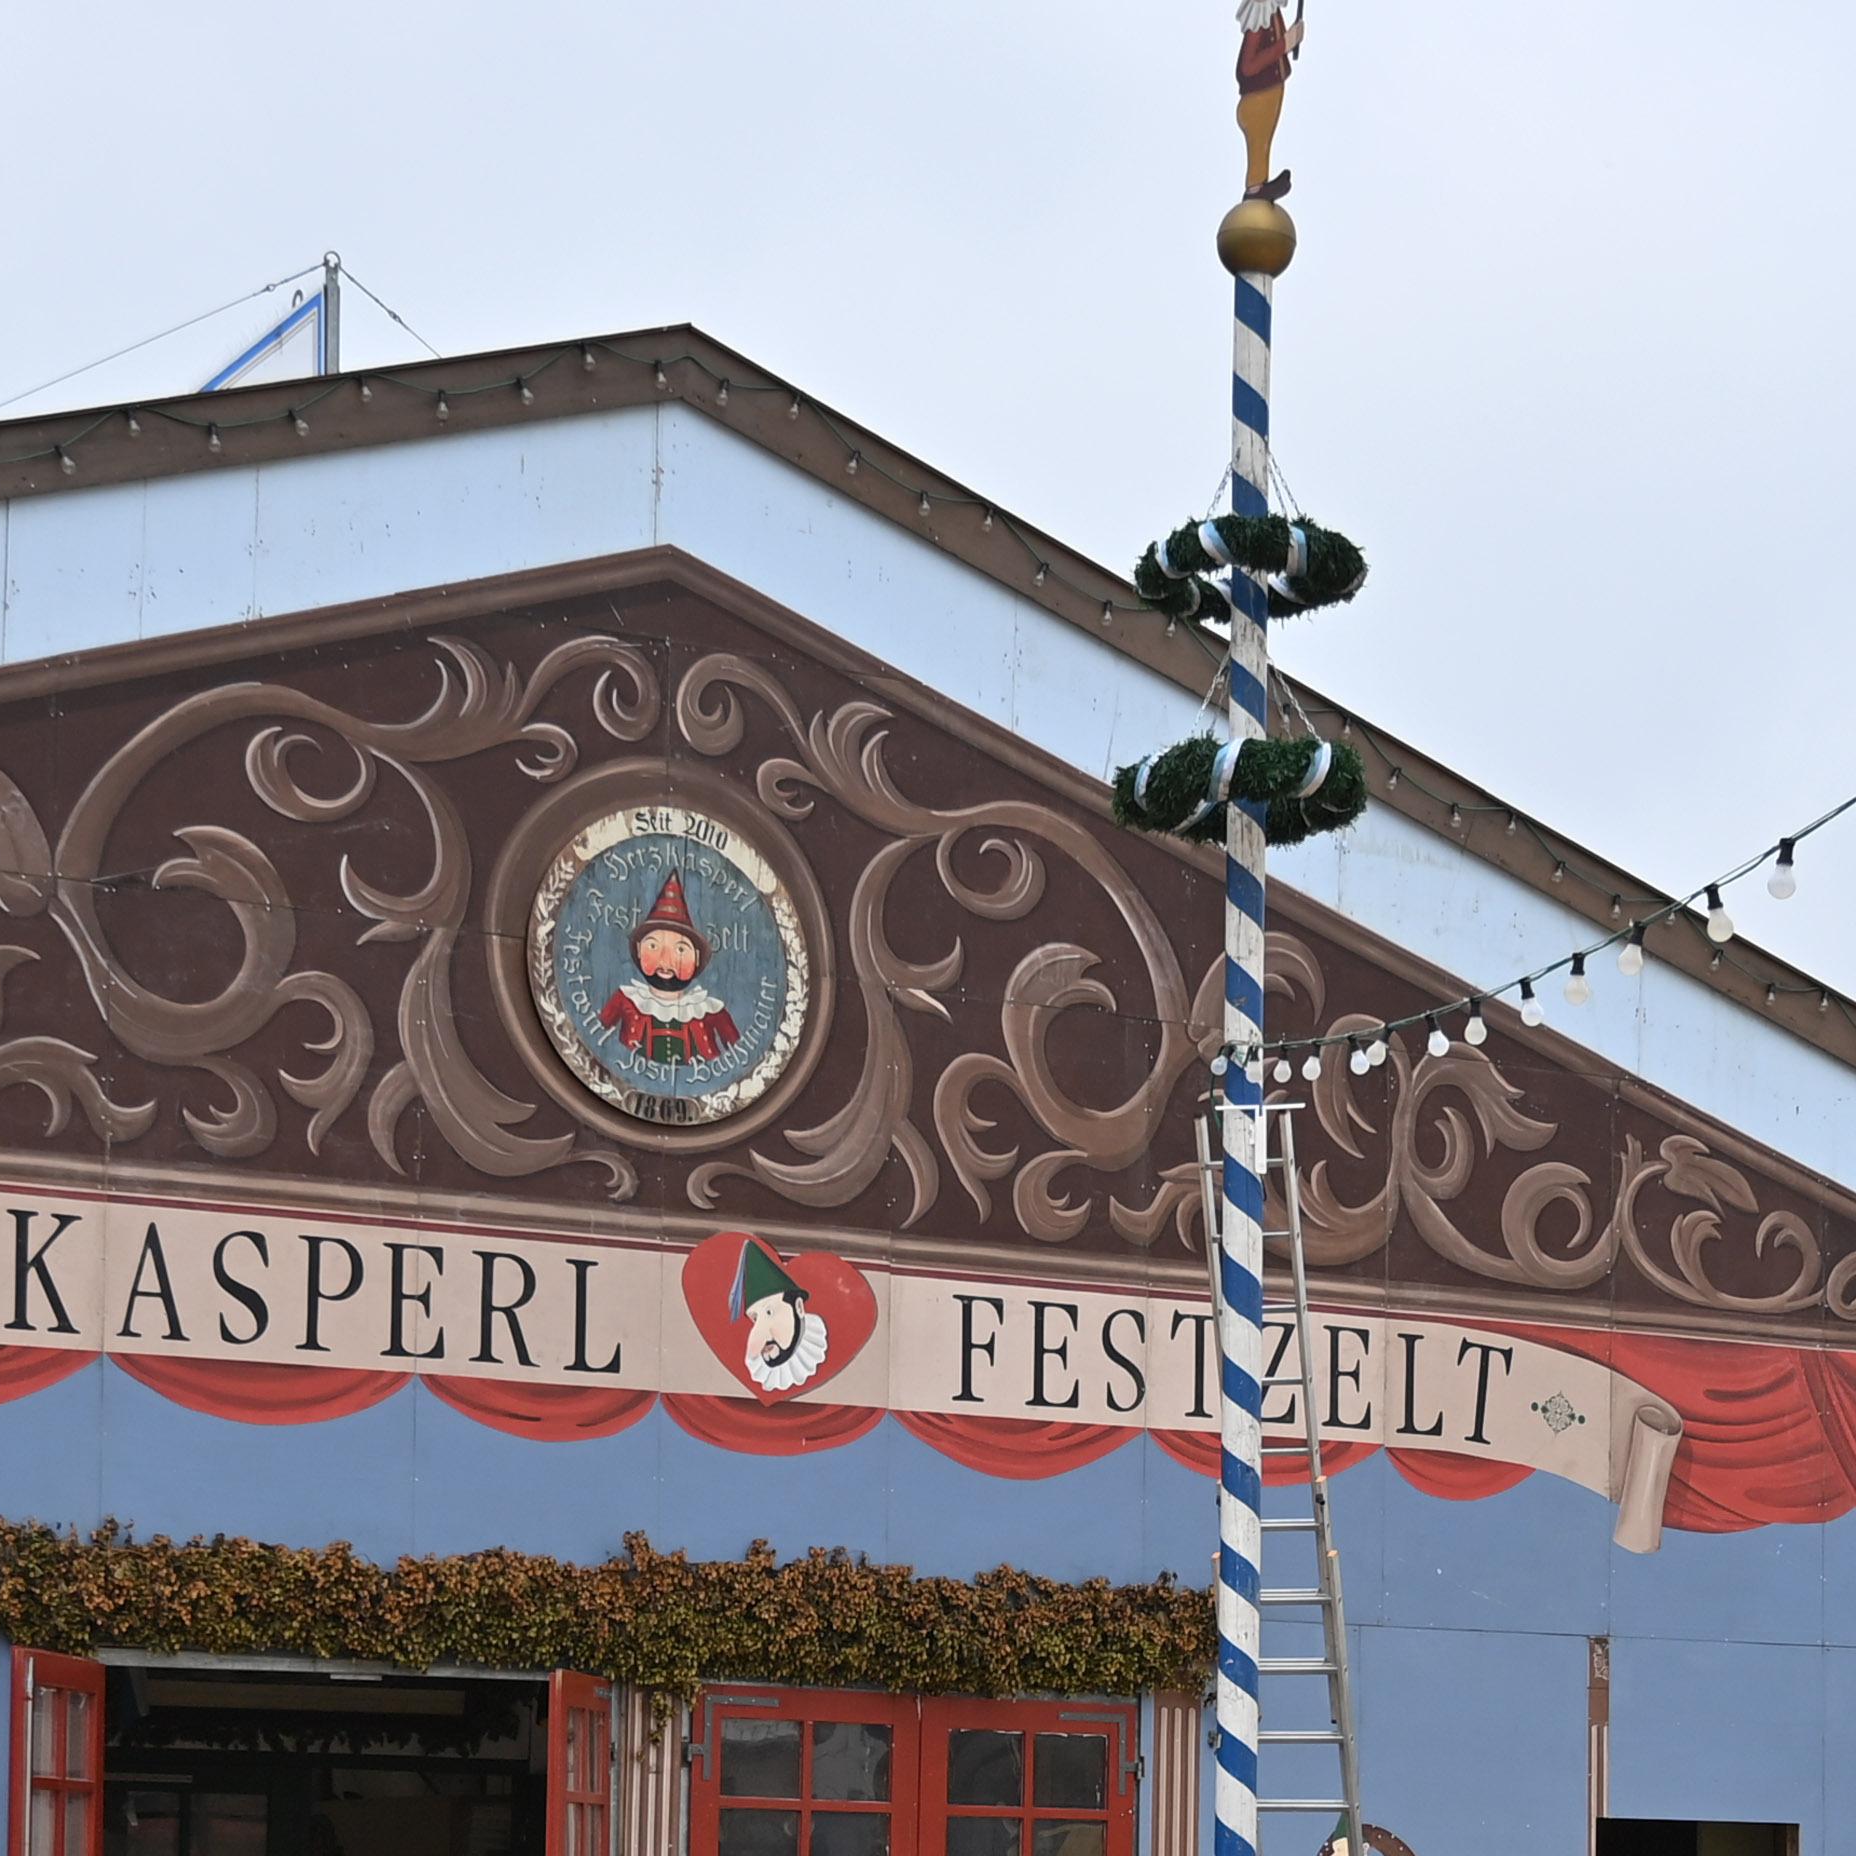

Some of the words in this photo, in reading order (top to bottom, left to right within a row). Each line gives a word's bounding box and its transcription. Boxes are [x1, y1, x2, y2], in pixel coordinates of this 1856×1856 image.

[634, 811, 672, 833] Seit
[684, 815, 729, 850] 2010
[586, 888, 642, 930] Fest
[616, 1040, 681, 1087] Josef
[950, 1293, 1514, 1446] FESTZELT
